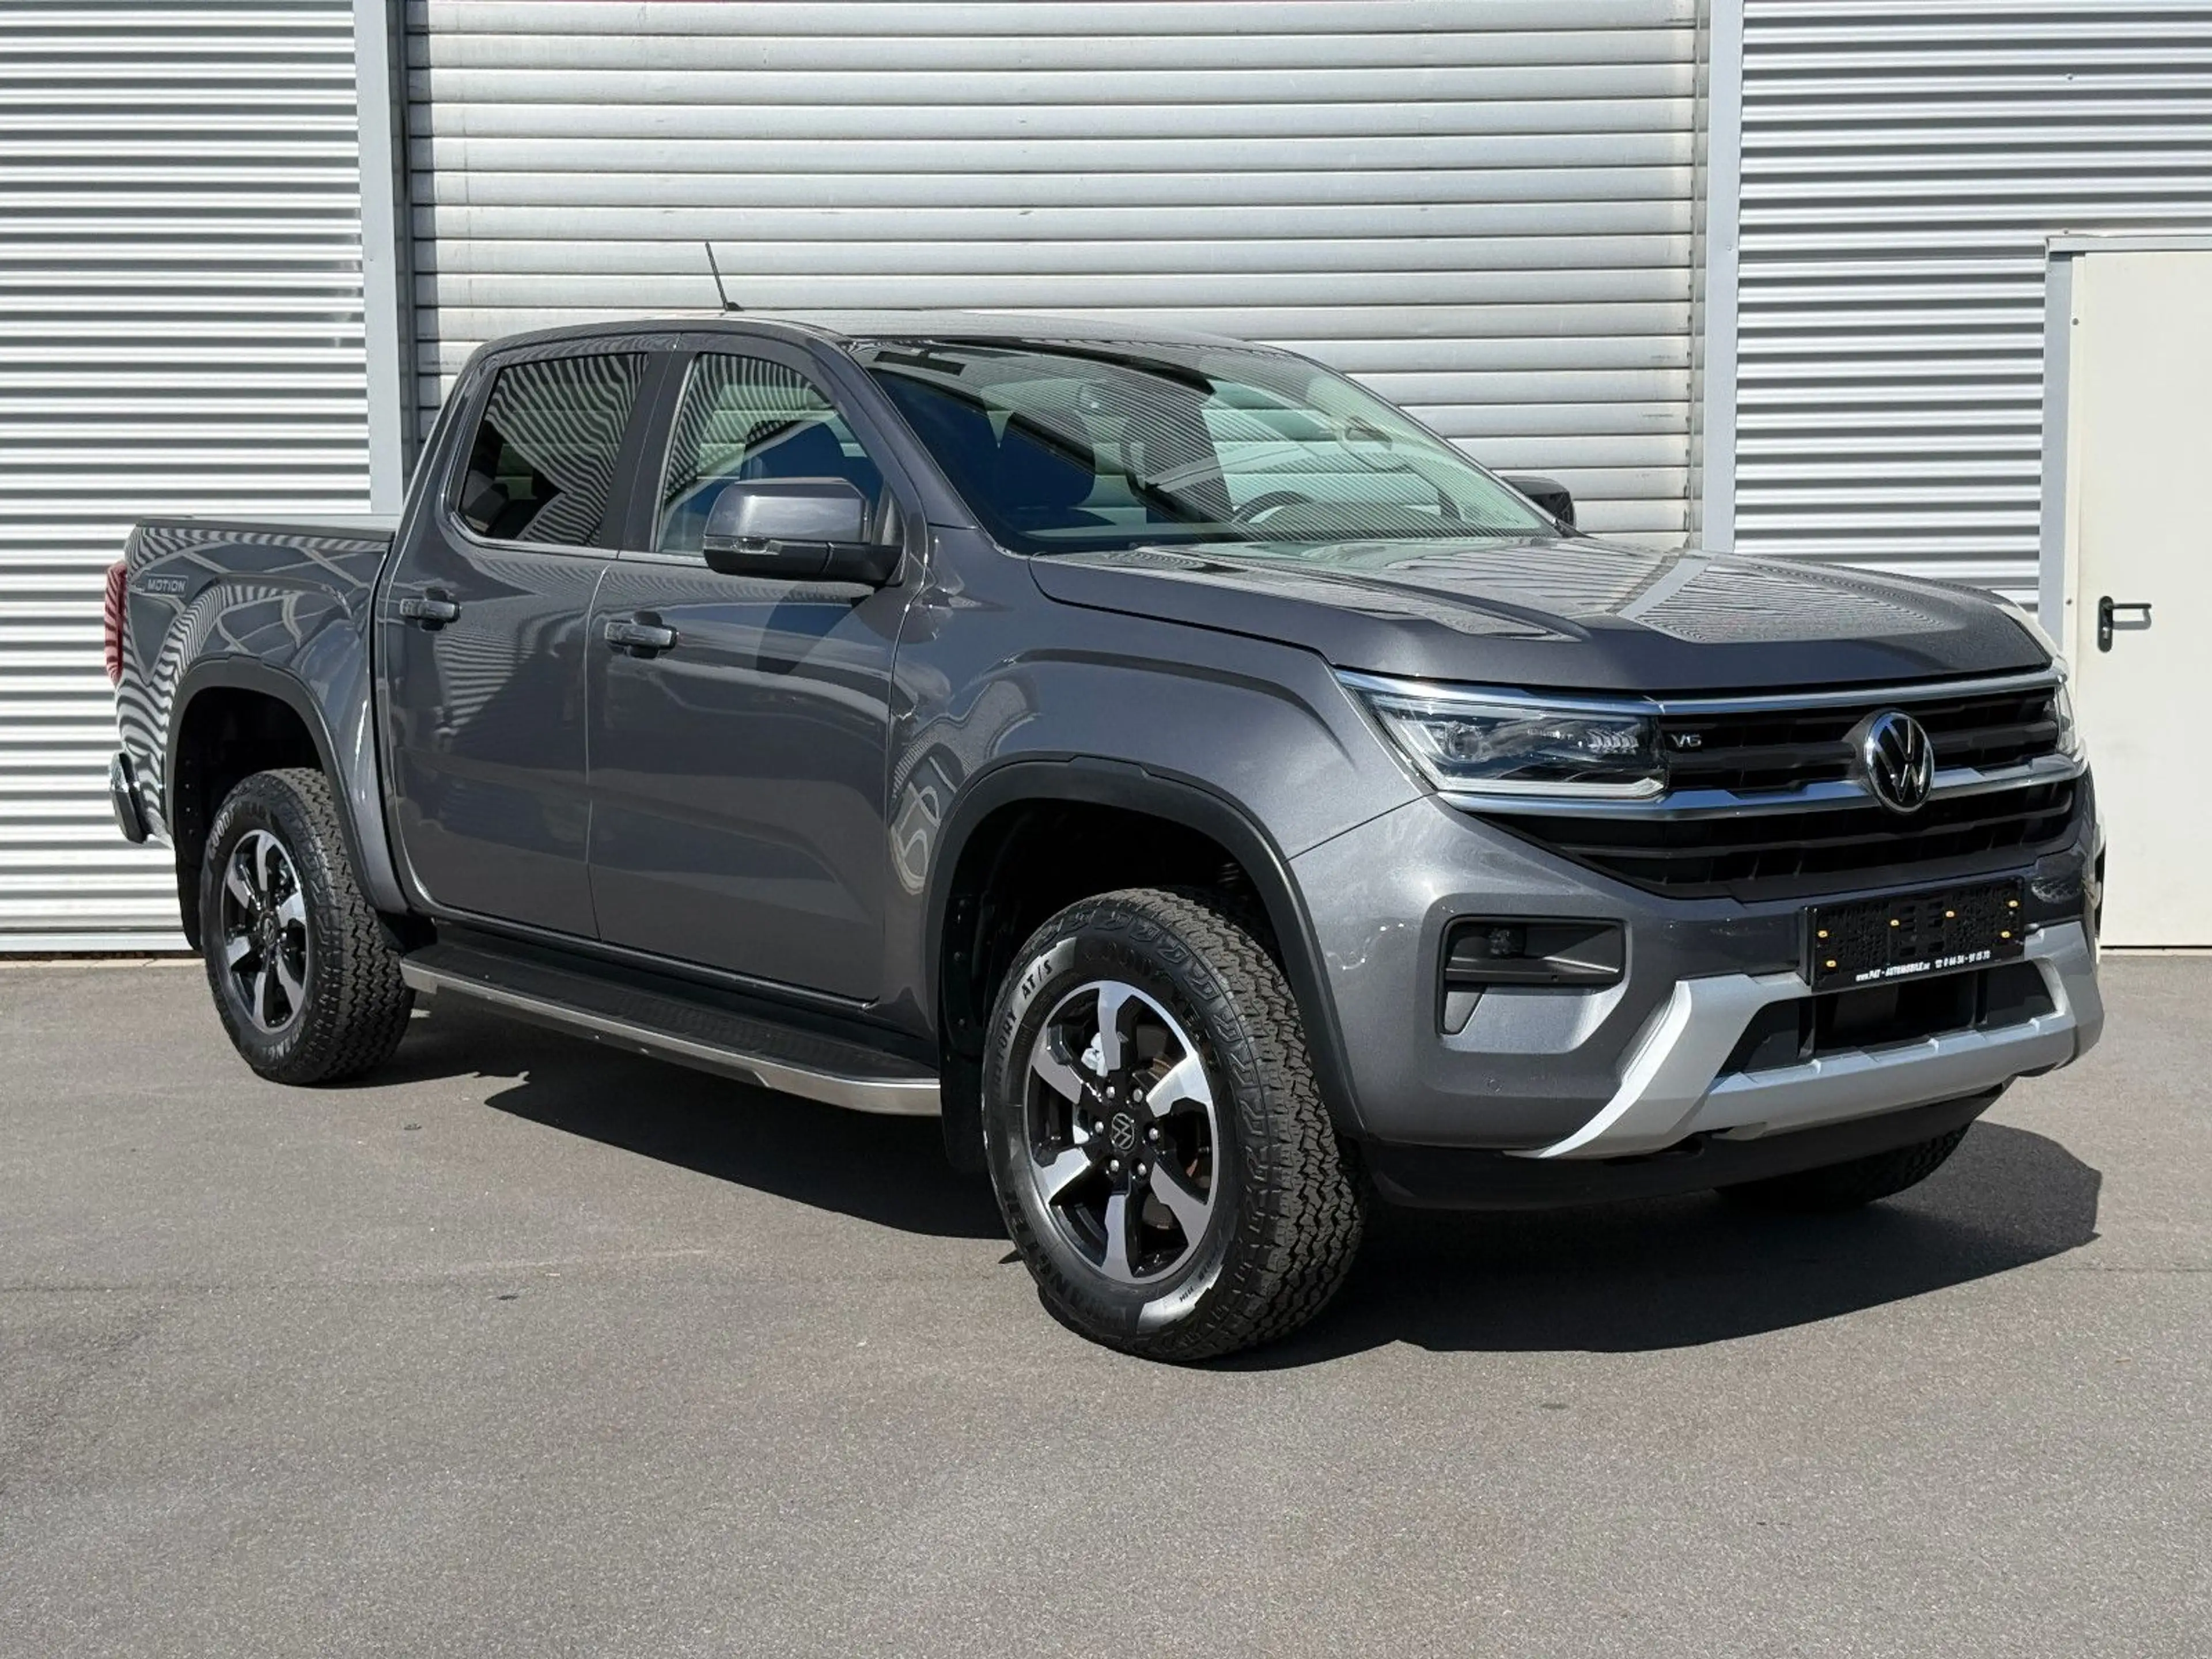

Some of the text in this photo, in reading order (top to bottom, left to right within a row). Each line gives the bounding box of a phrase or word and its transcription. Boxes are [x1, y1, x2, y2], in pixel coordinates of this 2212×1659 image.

[147, 578, 186, 593] MOTION
[1671, 734, 1702, 748] V6
[1021, 959, 1053, 999] AT/S
